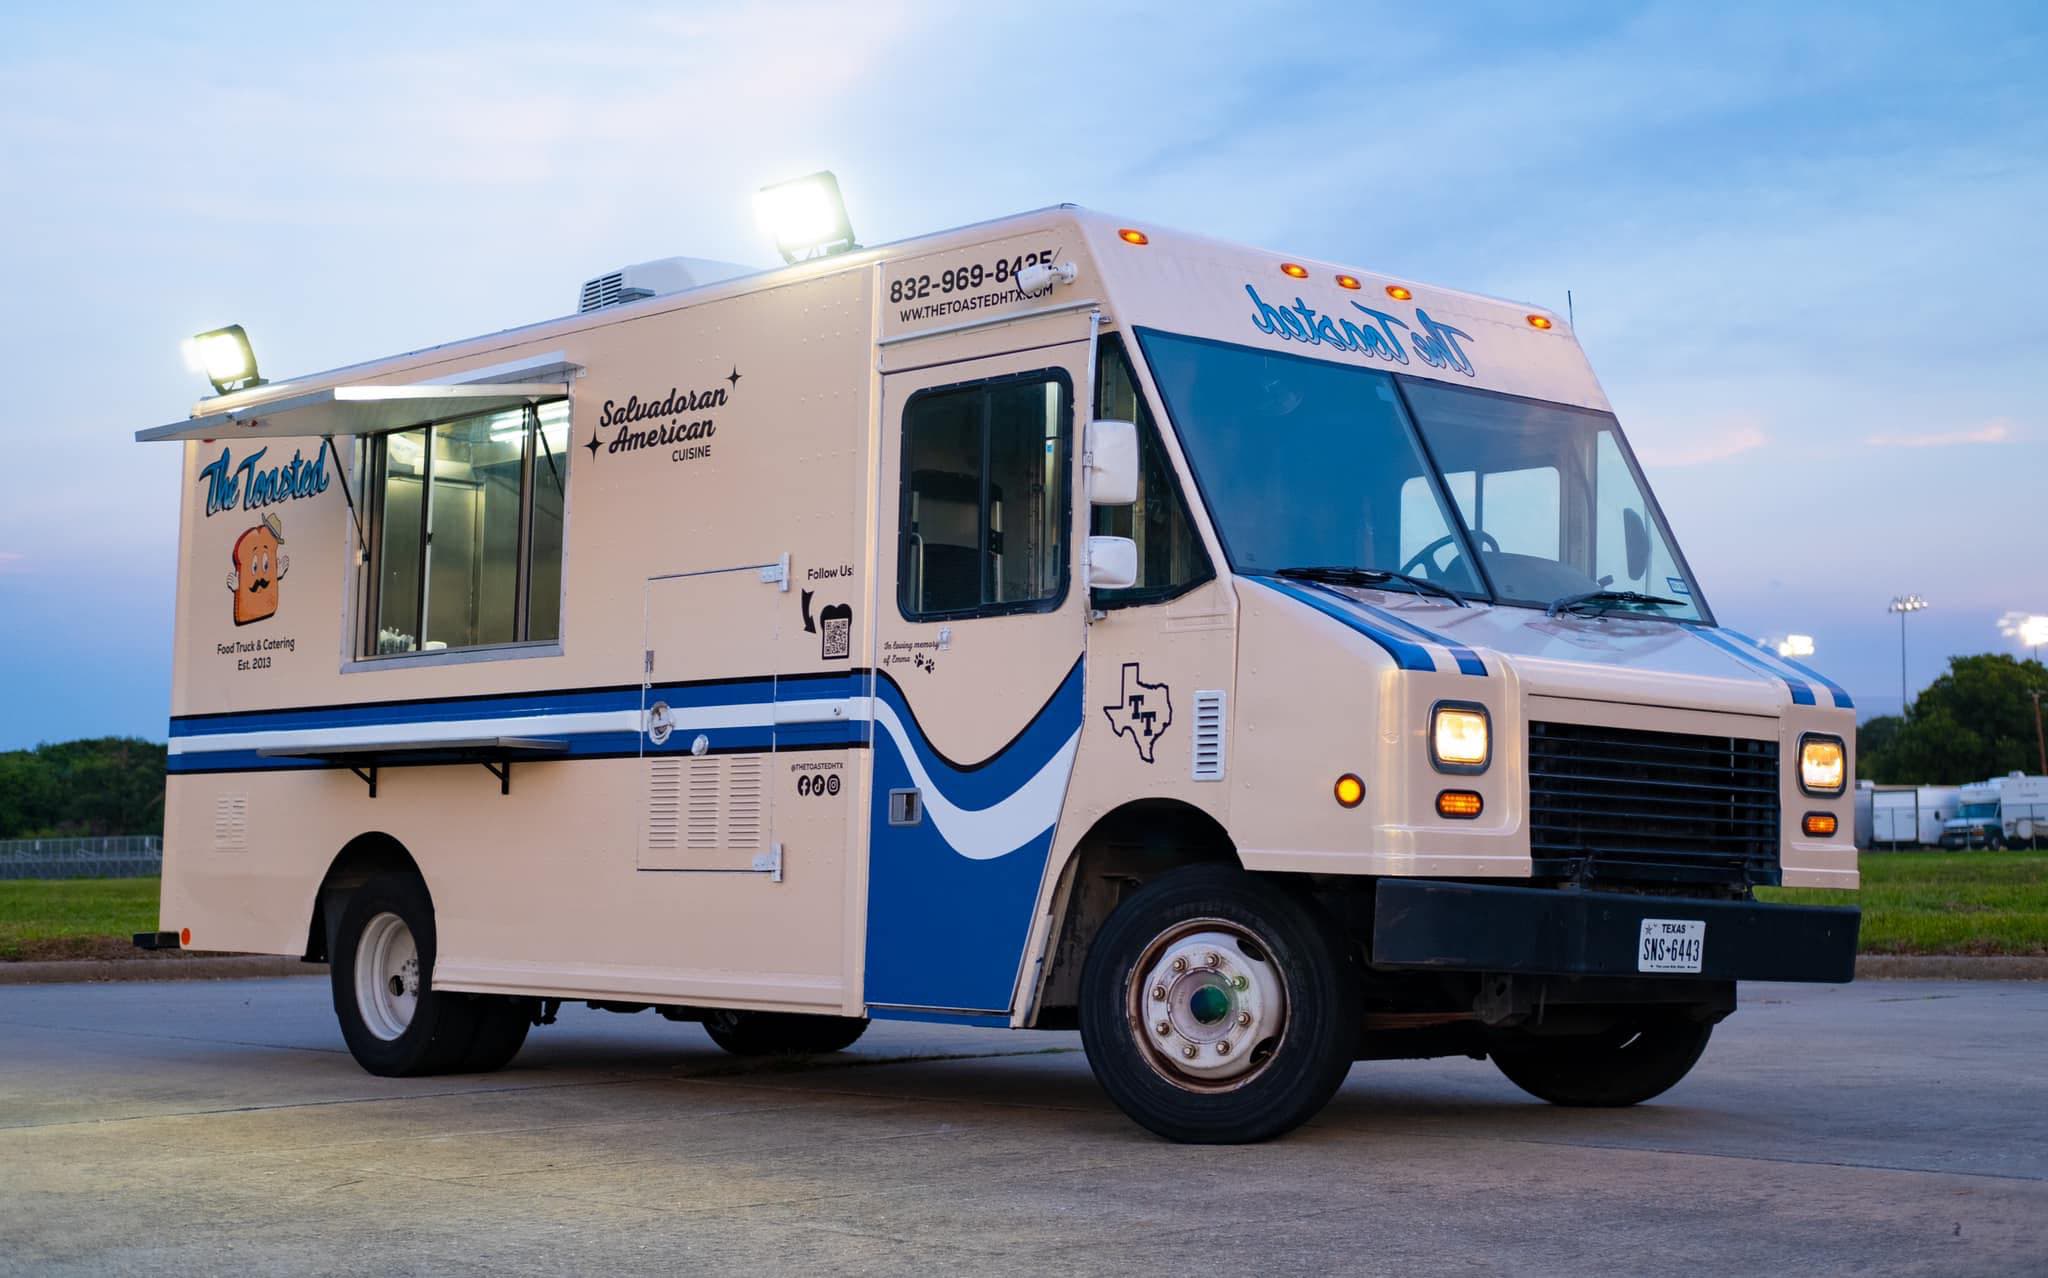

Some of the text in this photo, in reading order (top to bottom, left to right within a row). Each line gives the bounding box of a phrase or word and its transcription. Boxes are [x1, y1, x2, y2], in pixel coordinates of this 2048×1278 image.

[600, 387, 728, 427] Salvadoran
[608, 419, 716, 454] American
[672, 445, 711, 462] CUISINE
[199, 440, 330, 517] The Toasted
[808, 567, 838, 580] Follow
[217, 637, 295, 655] Food Truck & Catering
[893, 641, 913, 652] loving
[914, 640, 940, 650] memory
[238, 656, 272, 671] Est. 2013
[883, 655, 891, 667] of
[1662, 923, 1686, 934] TEXAS
